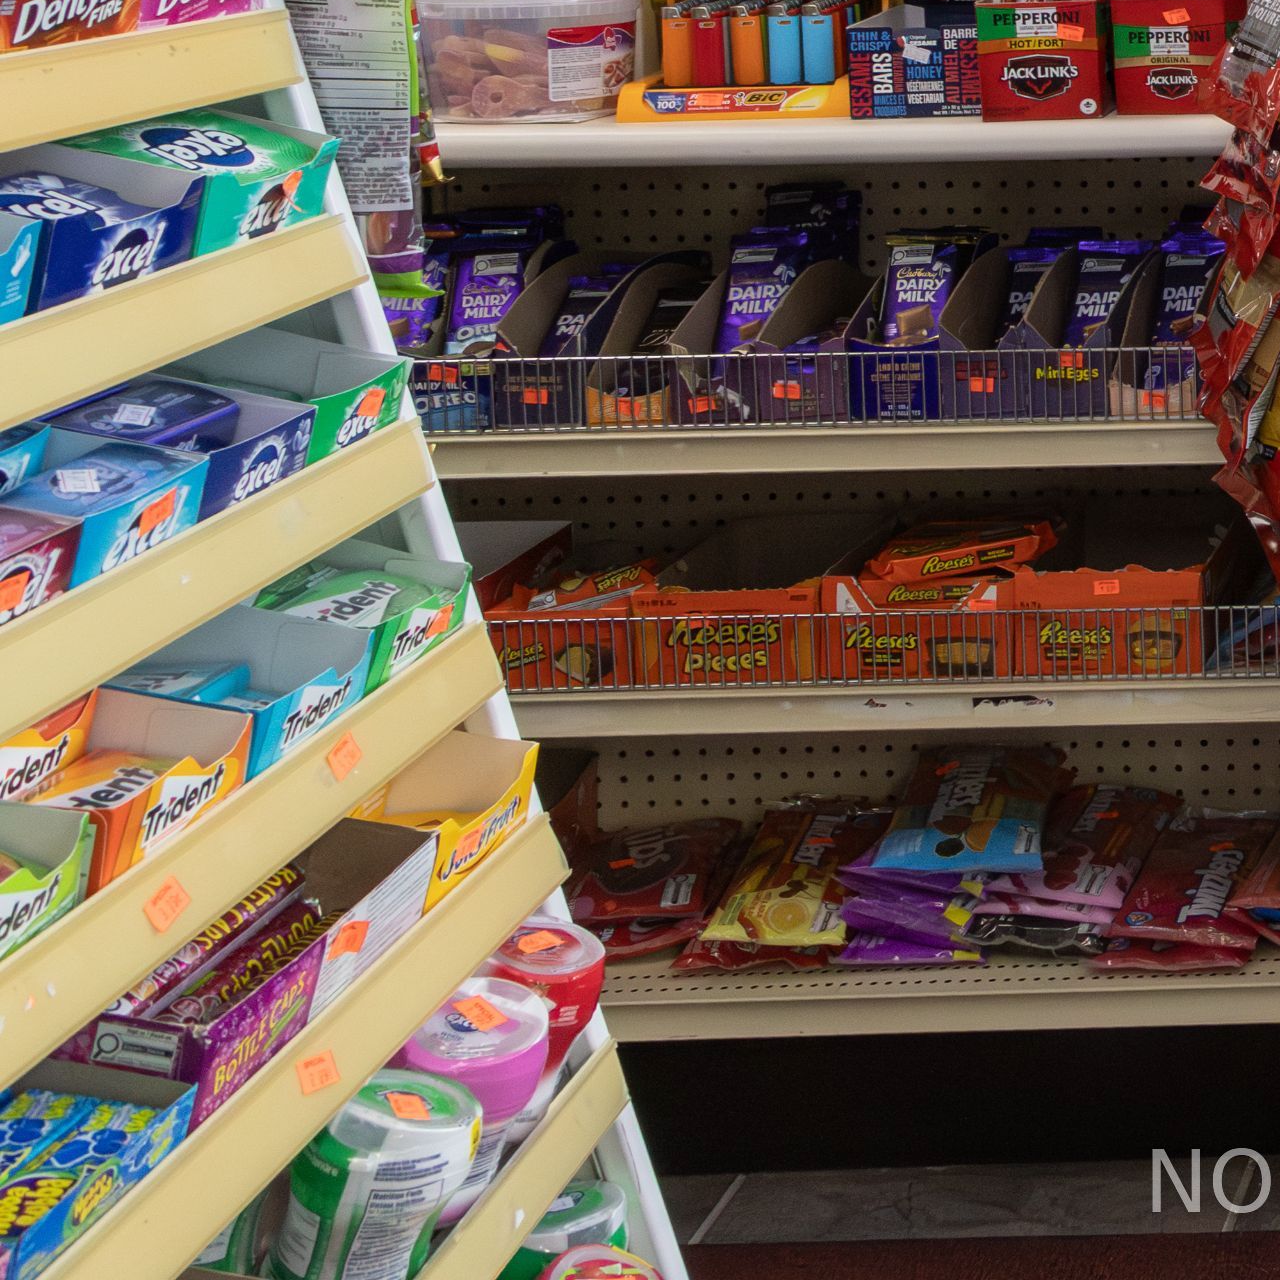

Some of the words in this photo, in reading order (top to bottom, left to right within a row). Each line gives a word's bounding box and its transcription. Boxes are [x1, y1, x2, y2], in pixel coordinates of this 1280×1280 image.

[992, 11, 1080, 27] PEPPERONI
[851, 32, 879, 40] THIN
[944, 29, 978, 39] BARRE
[1128, 29, 1211, 45] PEPPERONI
[850, 42, 892, 51] CRISPY
[944, 40, 958, 49] DE
[1008, 39, 1065, 49] HOT/FORT
[1149, 55, 1191, 64] ORIGINAL
[872, 53, 892, 94] BARS
[907, 67, 942, 79] HONEY
[1001, 66, 1034, 81] JACK
[1146, 73, 1171, 88] JACK
[852, 53, 872, 116] SESAME
[907, 93, 944, 105] VEGETARIAN
[92, 221, 166, 286] excel
[895, 278, 947, 291] DAIRY
[462, 293, 511, 308] DAIRY
[728, 285, 790, 302] DAIRY
[897, 289, 938, 303] MILK
[1076, 291, 1121, 305] DAIR
[464, 305, 502, 319] MILK
[730, 299, 778, 315] MILK
[1036, 365, 1066, 380] Mini
[1067, 366, 1099, 381] Eggs
[235, 454, 287, 500] excel
[920, 553, 975, 577] Reese's
[886, 585, 940, 603] Reese's
[846, 625, 919, 651] Reese's
[1039, 621, 1112, 645] Reese's
[283, 676, 353, 746] Trident
[144, 763, 226, 847] Trident
[213, 1021, 270, 1096] BOTTLE
[268, 971, 306, 1035] CAPS
